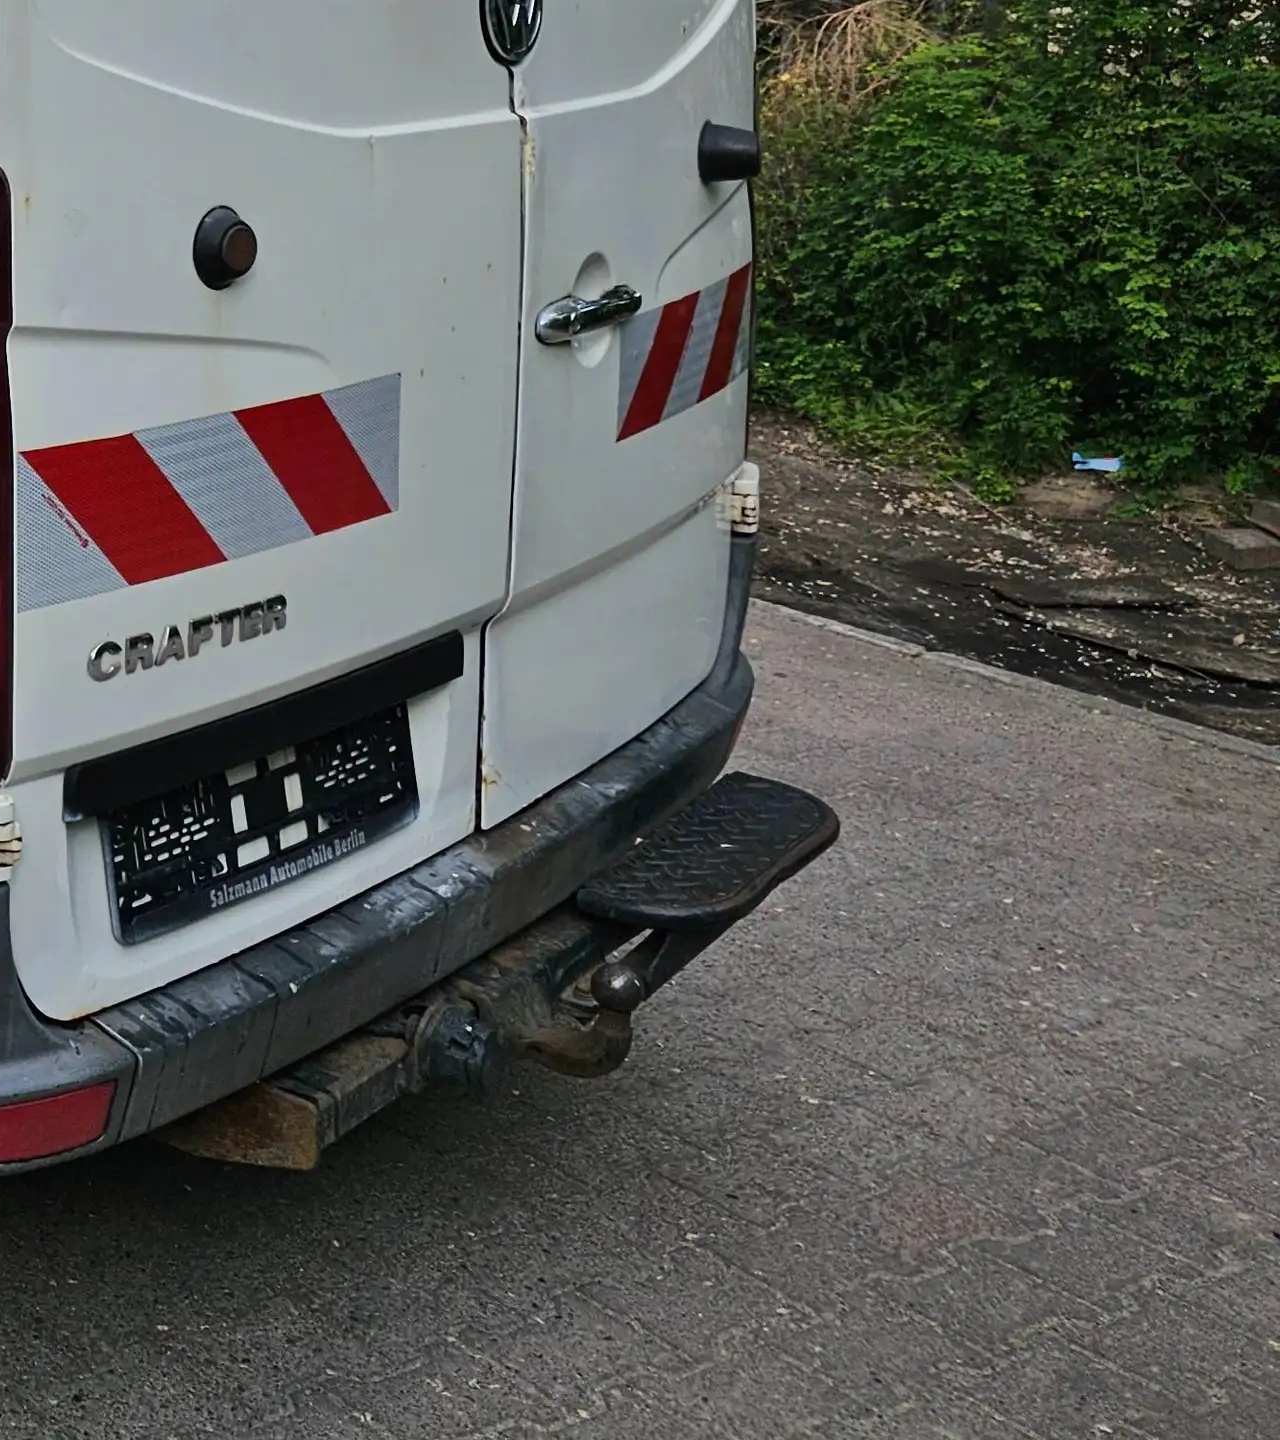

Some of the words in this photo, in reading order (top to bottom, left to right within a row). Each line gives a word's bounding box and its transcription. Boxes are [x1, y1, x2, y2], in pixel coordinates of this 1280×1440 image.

[86, 593, 288, 683] CRAFTER
[209, 872, 269, 908] Salzmann
[270, 843, 334, 885] Automobile
[333, 828, 366, 857] Berlin
